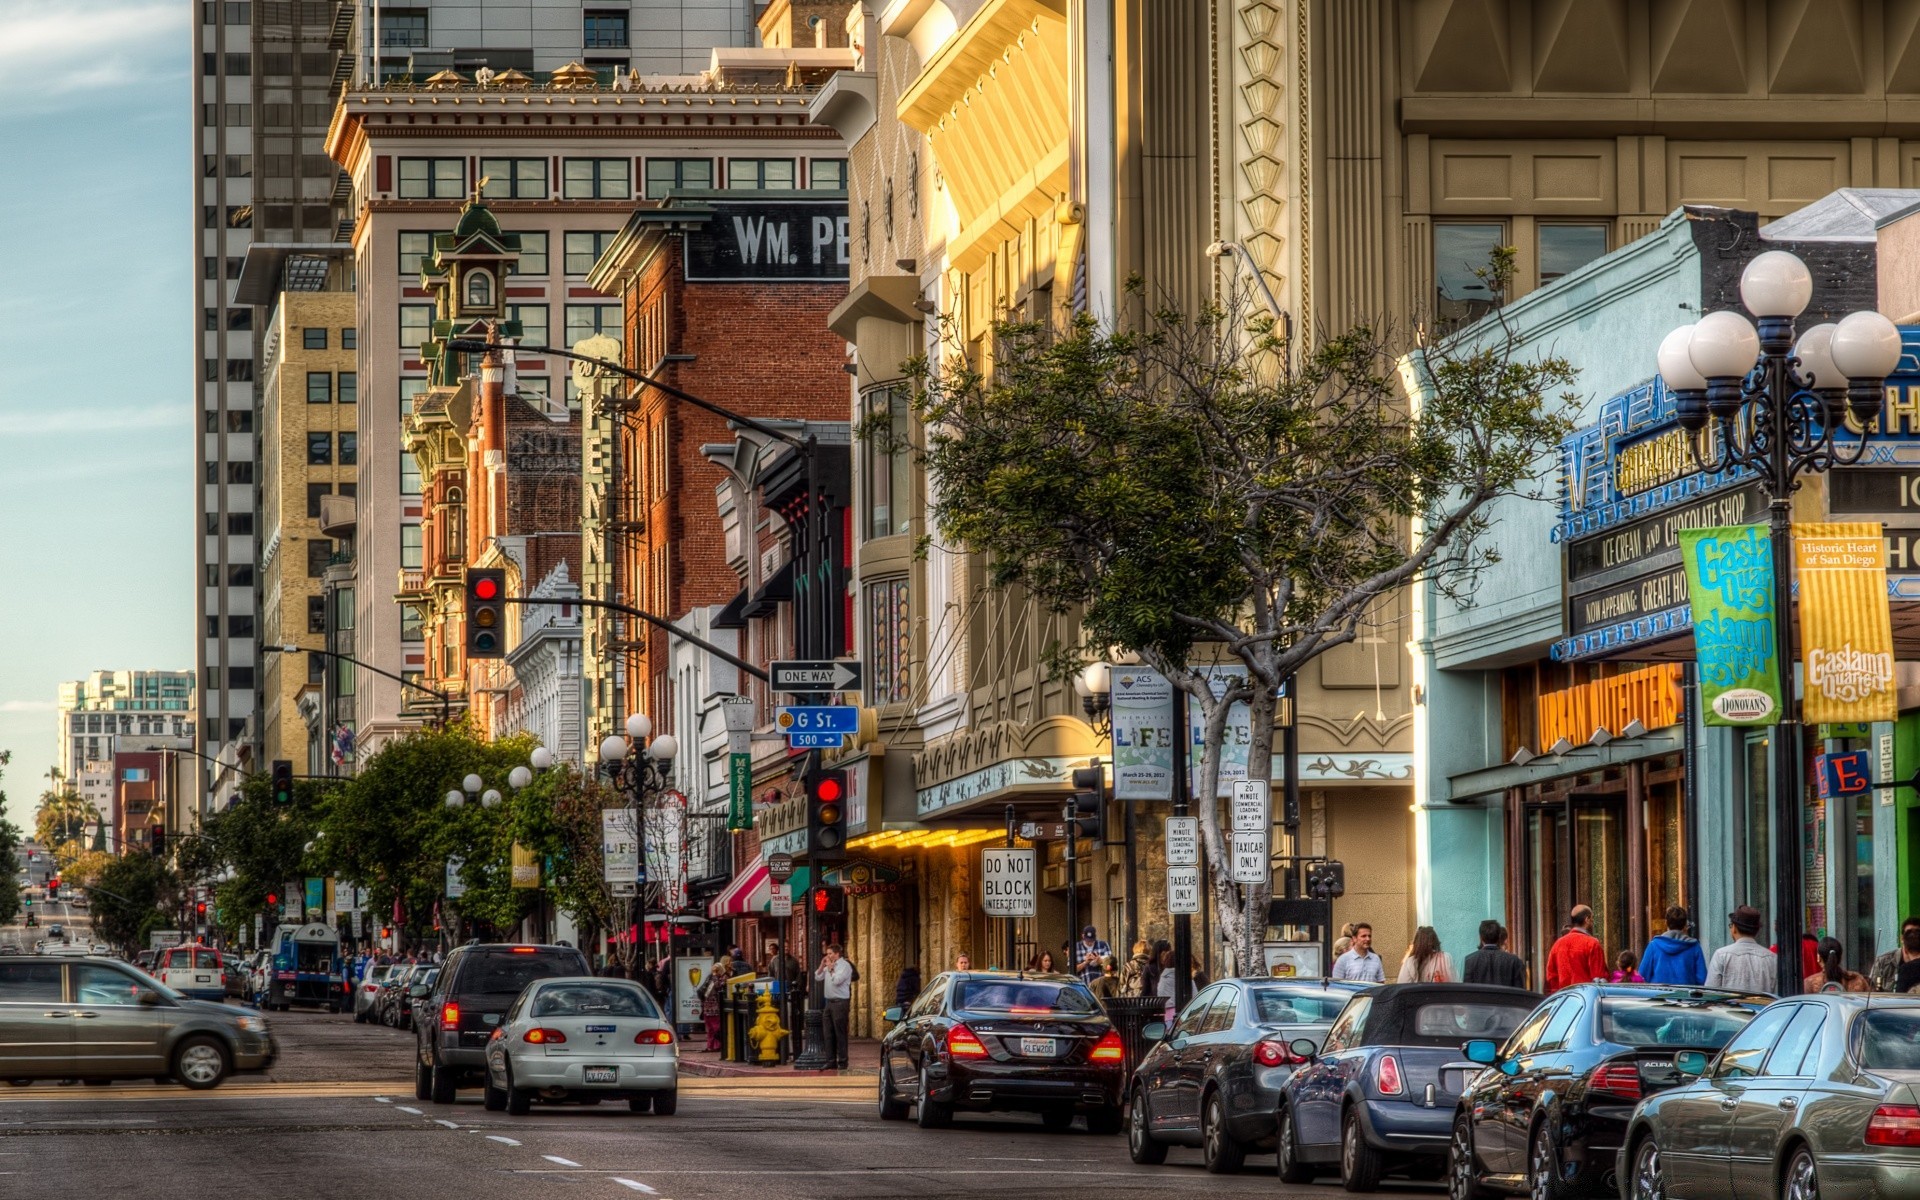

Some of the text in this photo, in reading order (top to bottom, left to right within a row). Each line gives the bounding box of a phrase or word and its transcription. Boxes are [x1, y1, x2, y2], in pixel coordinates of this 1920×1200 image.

[1602, 492, 1746, 569] ICE CREAM AND CHOCOLATE SHOP
[1802, 543, 1877, 553] Historic Heart
[1806, 554, 1876, 567] of San Diego
[1585, 570, 1691, 624] NOW APPEARING: GREAT! HO
[1809, 642, 1893, 686] Gaslamp
[784, 671, 834, 682] ONE WAY
[1136, 675, 1152, 683] ACS
[1538, 662, 1682, 754] URBAN OUTFITTERS
[1722, 696, 1767, 714] DONOVAN'S
[797, 712, 809, 728] G
[799, 734, 817, 745] 500
[1116, 727, 1171, 748] LIFE
[1831, 755, 1867, 792] E
[1035, 826, 1043, 836] G
[1177, 821, 1186, 829] 20
[1235, 842, 1264, 853] TAXICAB
[986, 858, 1031, 873] DO NOT
[1240, 857, 1258, 868] ONLY
[1170, 876, 1197, 886] TAXICAB
[985, 880, 1032, 895] BLOCK
[1175, 889, 1192, 900] ONLY
[985, 898, 1032, 910] INTERSECTION
